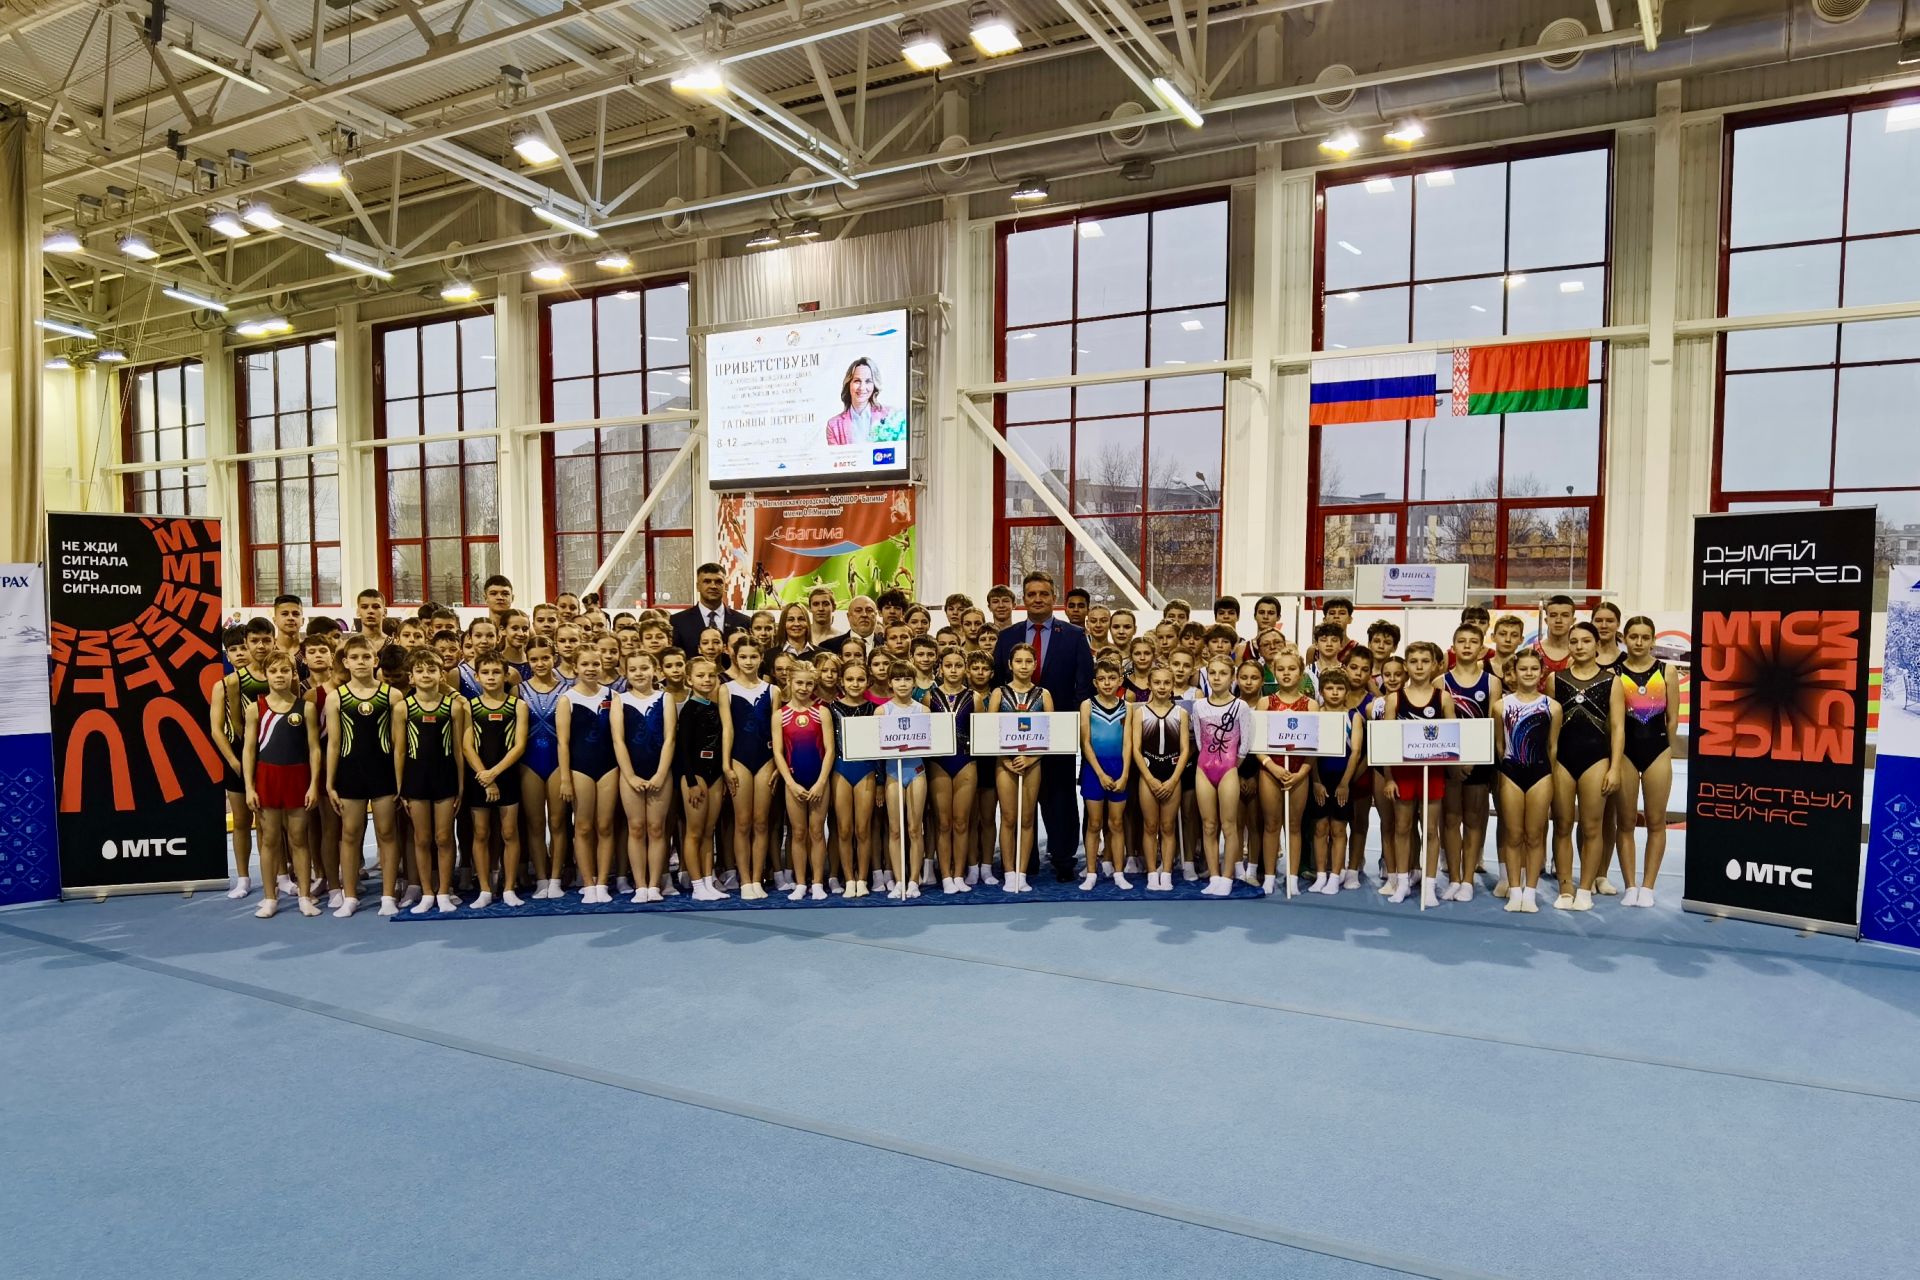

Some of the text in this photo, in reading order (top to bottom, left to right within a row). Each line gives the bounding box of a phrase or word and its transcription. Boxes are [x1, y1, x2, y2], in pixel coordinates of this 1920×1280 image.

[715, 353, 819, 376] ПРИВЕТСТВУЕМ
[61, 541, 118, 553] НЕ ЖДИ
[1703, 540, 1816, 563] ДУМАЙ
[62, 555, 128, 567] СИГНАЛА
[0, 576, 29, 588] РАХ
[62, 569, 100, 580] БУДЬ
[1702, 565, 1862, 586] НАПЕРЕД
[62, 583, 142, 595] СИГНАЛОМ
[1701, 611, 1819, 646] МТС
[884, 732, 927, 742] МОГИЛЕВ
[1005, 732, 1045, 742] ГОМЕЛЬ
[1278, 732, 1310, 741] БРЕСТ
[1697, 782, 1852, 810] ДЕЙСТВУЙ
[1696, 802, 1808, 827] СЕЙЧАС
[122, 837, 187, 858] МТС
[1745, 861, 1813, 890] МТС
